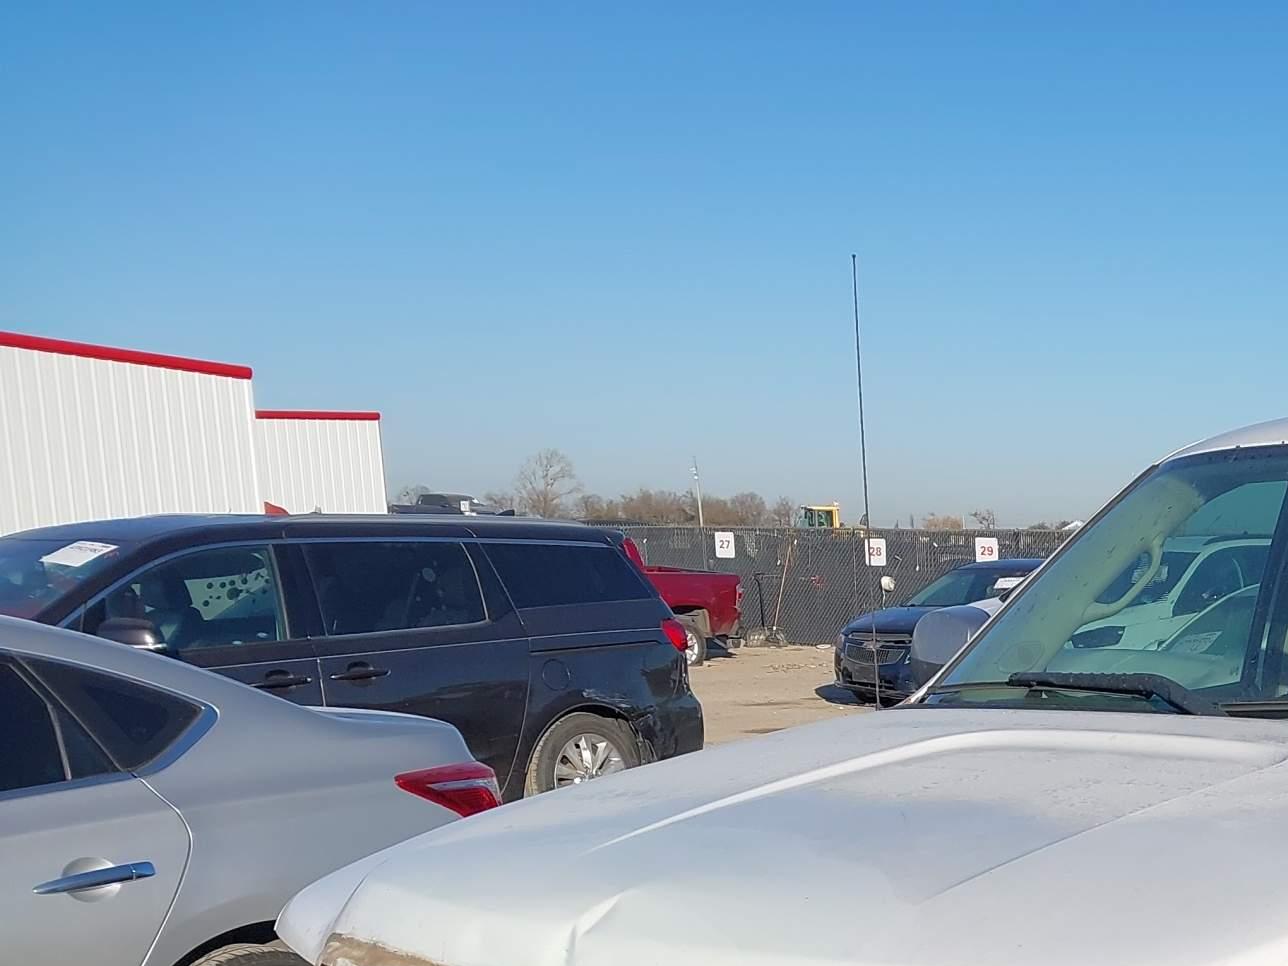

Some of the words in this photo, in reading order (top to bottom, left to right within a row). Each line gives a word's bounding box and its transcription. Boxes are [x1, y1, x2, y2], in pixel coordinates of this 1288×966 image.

[719, 539, 731, 549] 27
[869, 546, 882, 557] 28
[980, 545, 994, 556] 29
